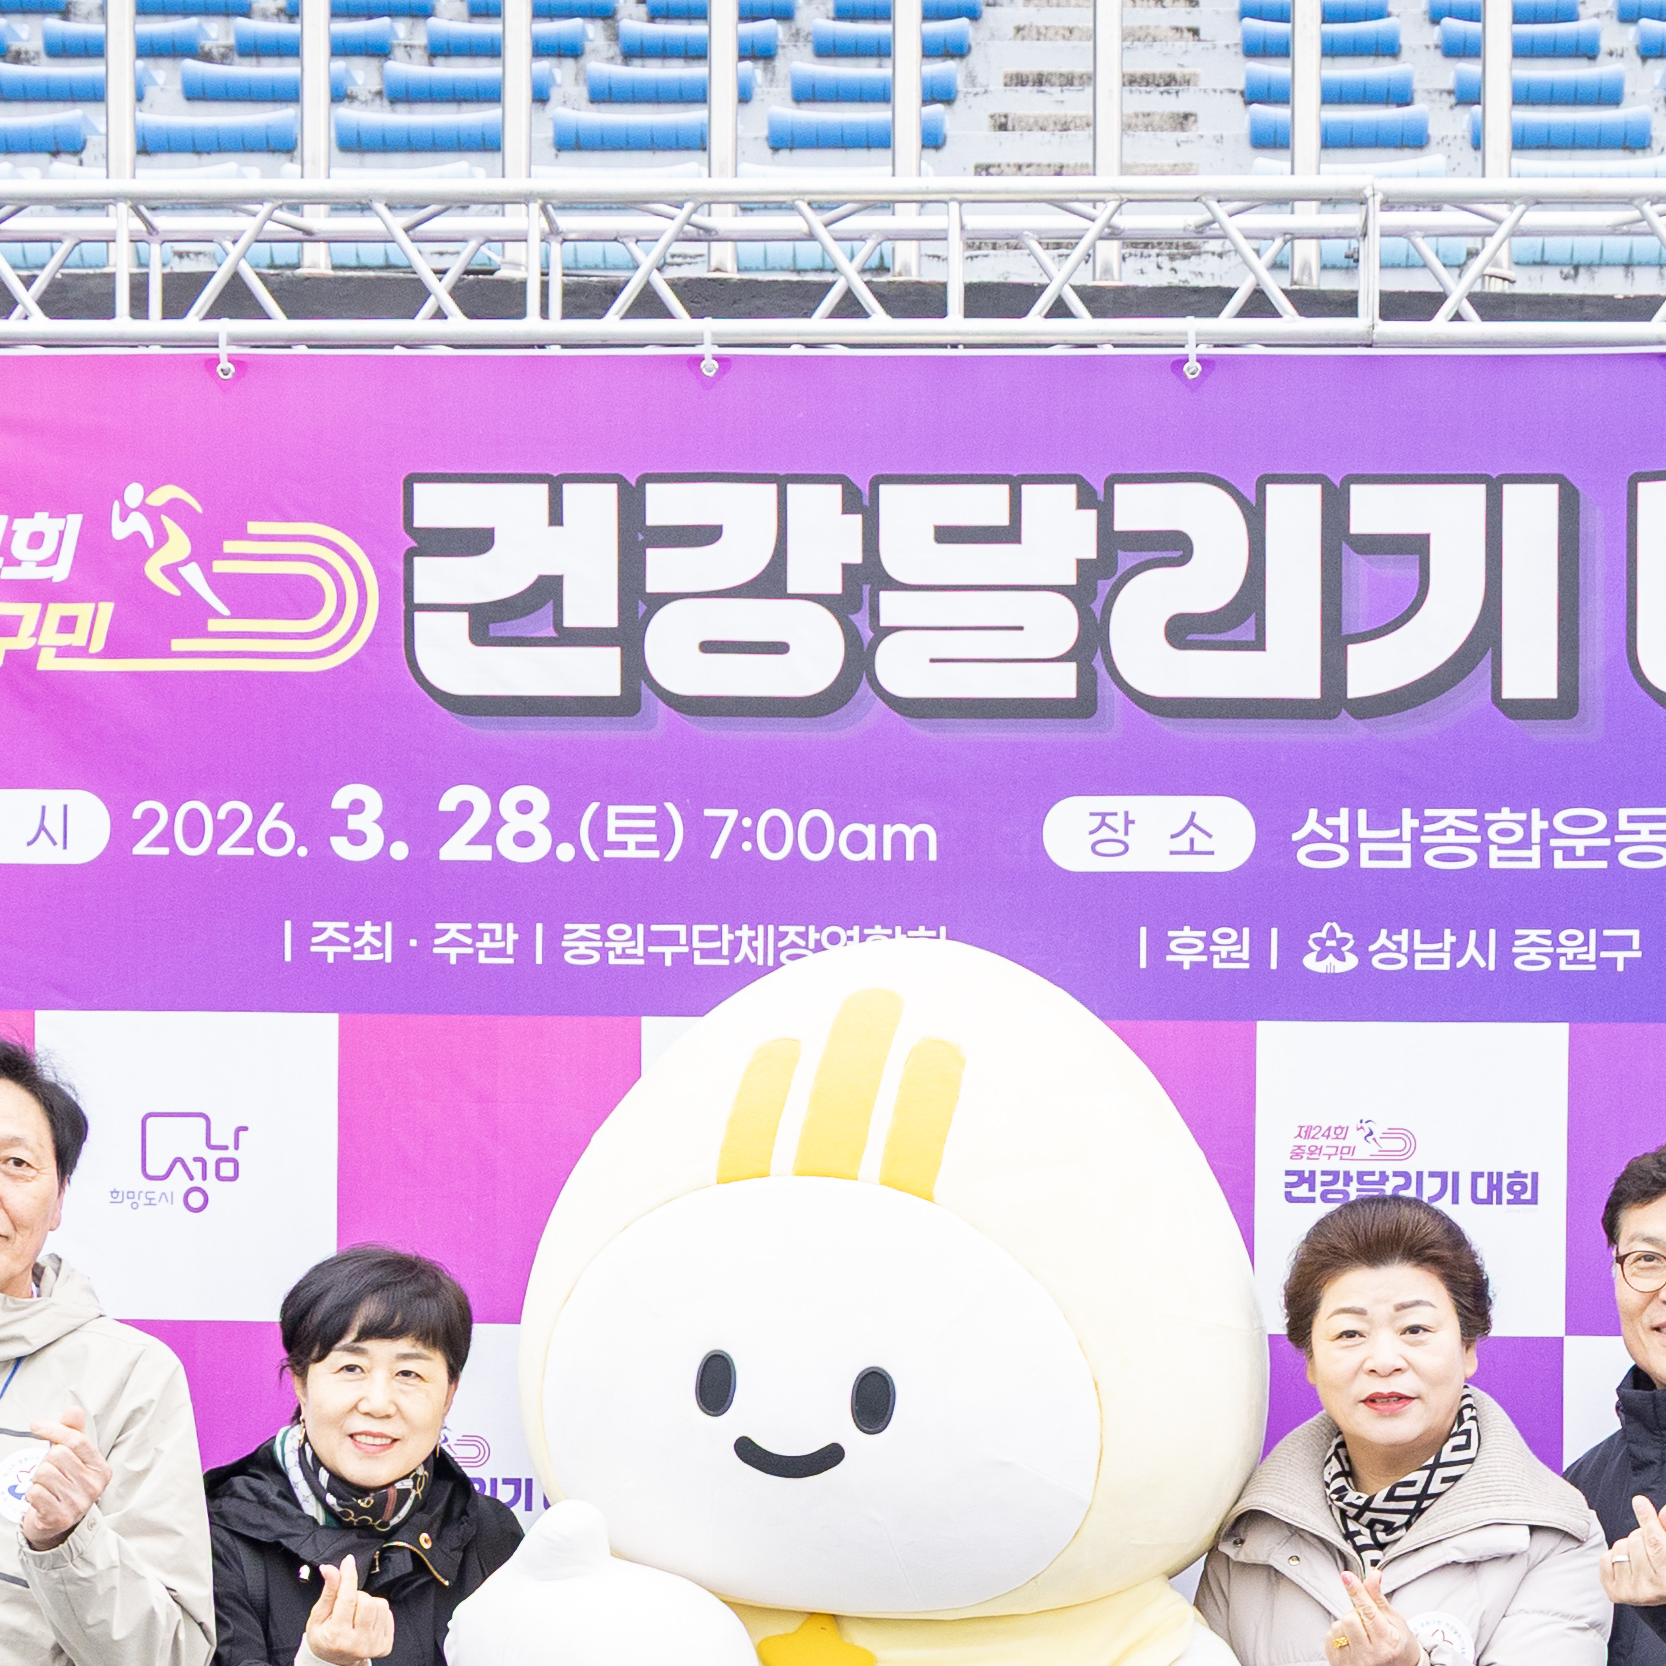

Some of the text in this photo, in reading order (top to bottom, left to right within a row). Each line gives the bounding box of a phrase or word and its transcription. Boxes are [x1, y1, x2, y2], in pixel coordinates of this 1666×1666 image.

[404, 472, 1579, 718] 건강달리기
[130, 800, 309, 858] 2026.
[703, 808, 938, 862] 7:00am
[1166, 926, 1252, 970] 후원
[1368, 926, 1643, 971] 성남시 중원구
[1294, 1124, 1350, 1141] 제24회
[1289, 1144, 1356, 1161] 중원구민
[109, 1187, 174, 1210] 희망도시
[1470, 1170, 1539, 1205] 대회
